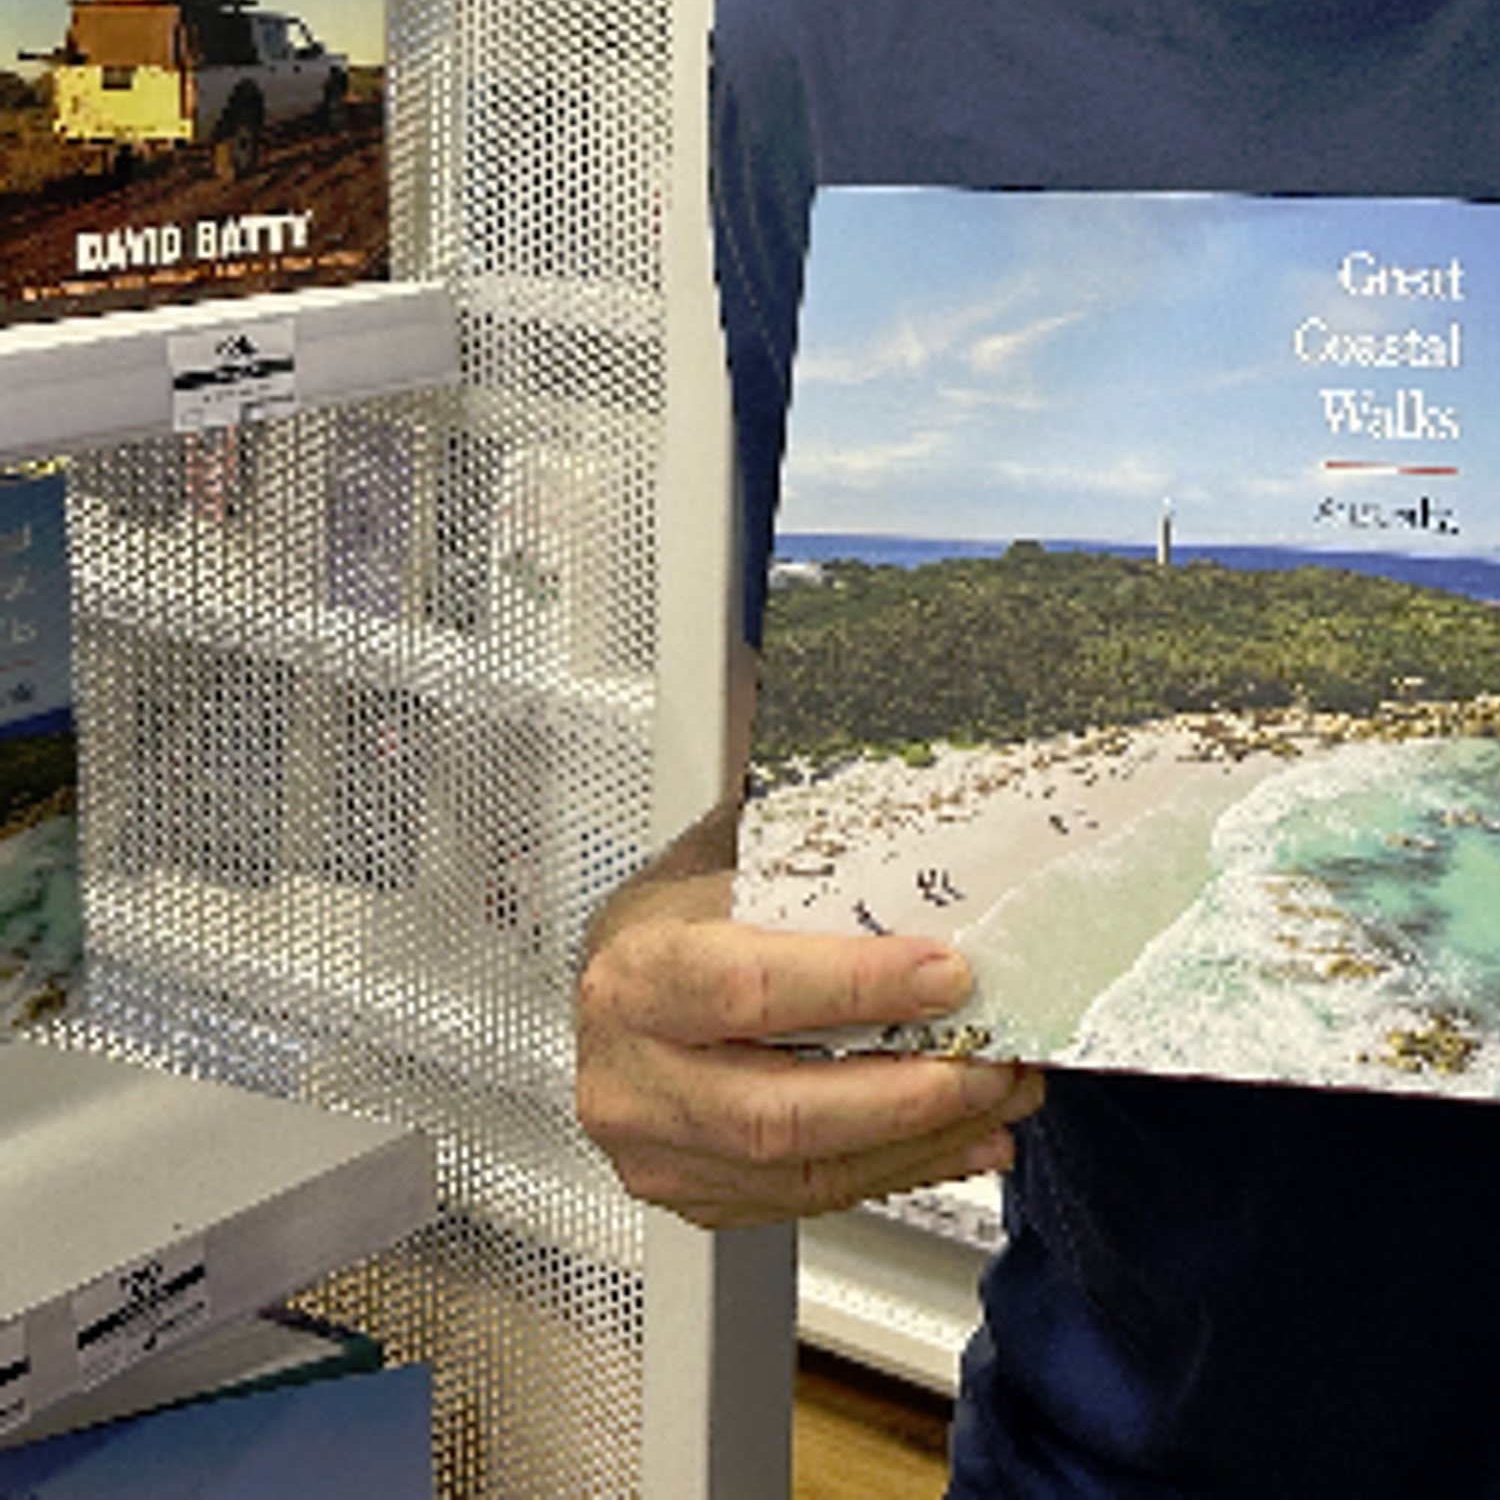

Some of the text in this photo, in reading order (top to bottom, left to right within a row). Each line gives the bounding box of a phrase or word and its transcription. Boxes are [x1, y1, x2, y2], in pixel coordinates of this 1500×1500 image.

[76, 209, 313, 272] DAVID BATTY
[1335, 249, 1465, 302] Great
[1292, 315, 1463, 368] Coastal
[1317, 387, 1461, 440] Walks
